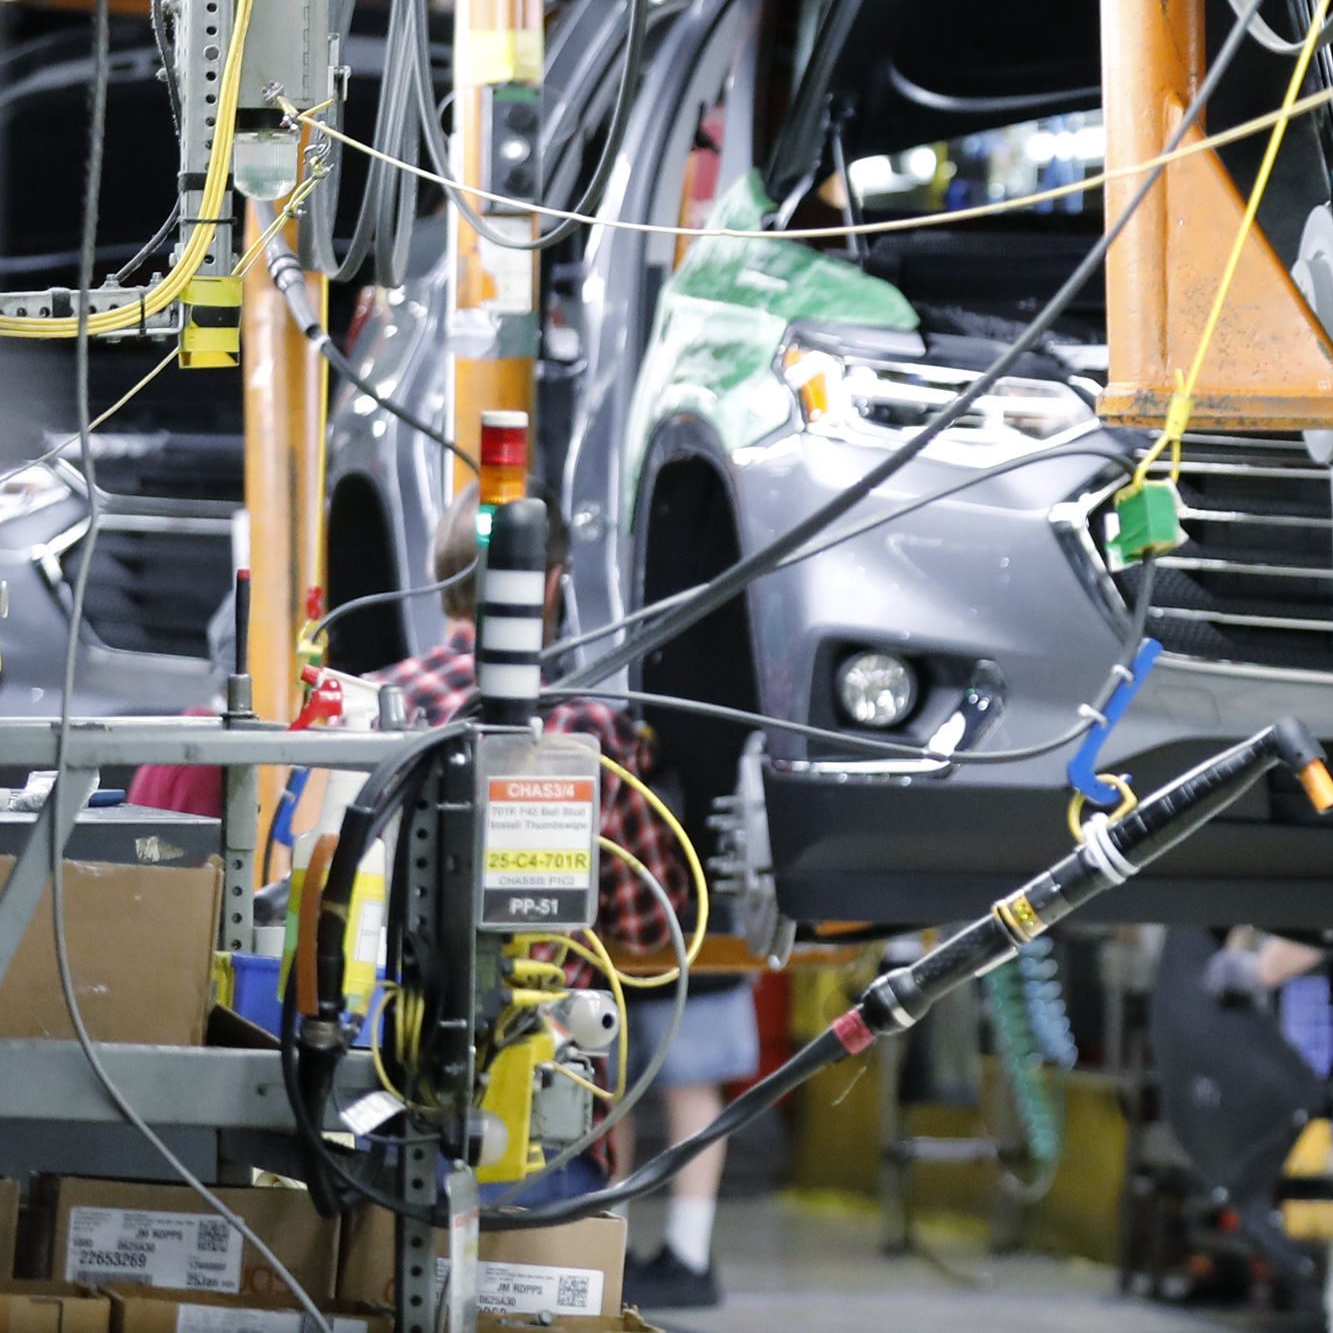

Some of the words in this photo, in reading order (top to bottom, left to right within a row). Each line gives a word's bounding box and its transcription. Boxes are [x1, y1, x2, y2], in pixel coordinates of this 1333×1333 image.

[507, 782, 576, 799] CHAS3/4
[562, 806, 586, 816] Stud
[490, 820, 522, 831] Install
[488, 853, 588, 870] 25-C4-701R
[499, 876, 546, 887] CHASSIS
[509, 897, 560, 916] PP-51
[497, 1282, 510, 1292] JM
[513, 1282, 544, 1296] RDPPS
